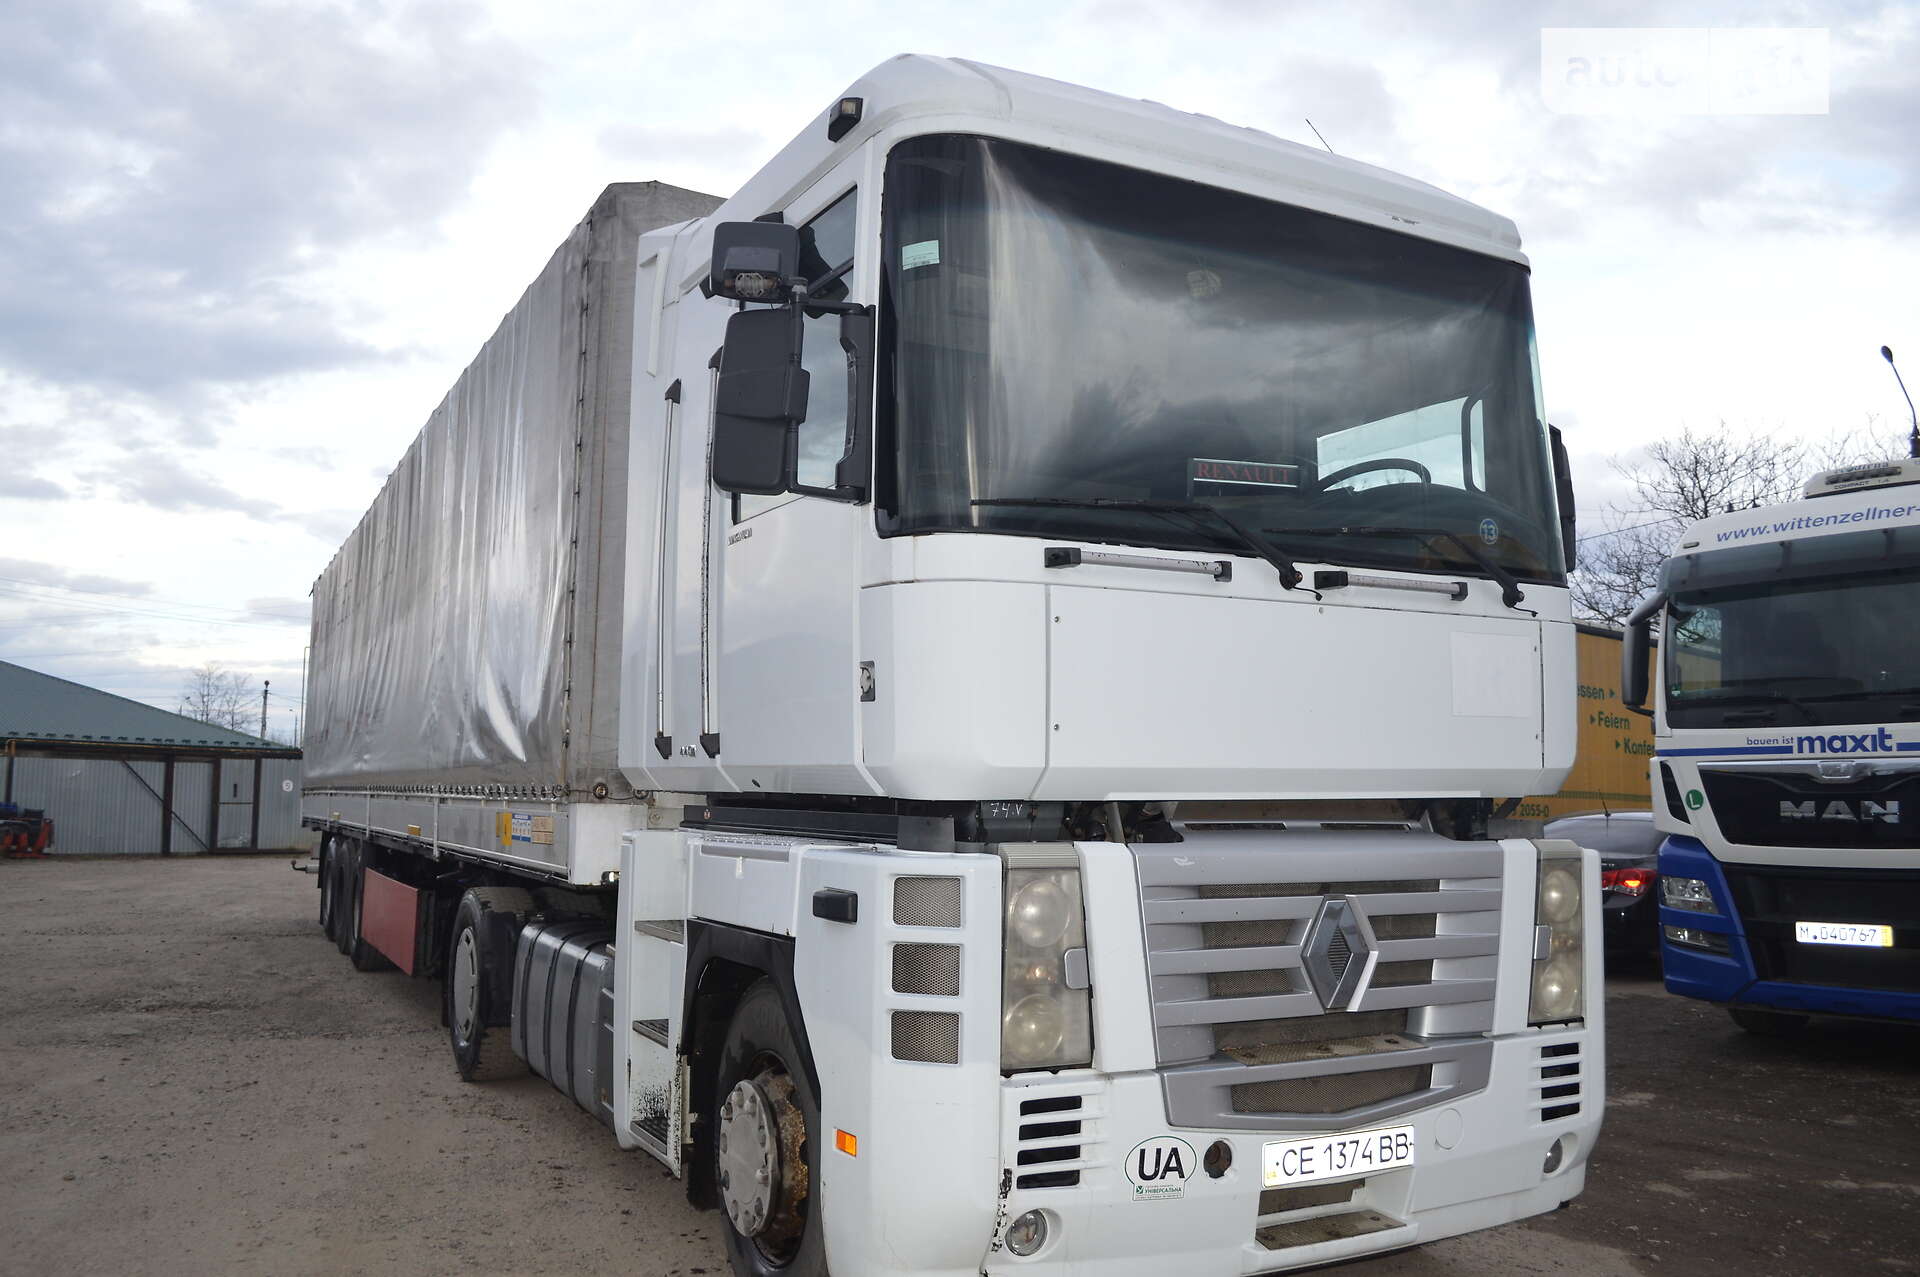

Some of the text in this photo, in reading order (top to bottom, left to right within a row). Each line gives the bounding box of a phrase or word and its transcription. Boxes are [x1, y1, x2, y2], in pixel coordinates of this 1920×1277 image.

[1194, 462, 1291, 484] RENAULT
[1598, 711, 1630, 729] Feiern
[1746, 727, 1893, 754] bauen ist maxit
[1779, 800, 1900, 824] MAN
[1138, 1147, 1186, 1181] UA
[1282, 1132, 1410, 1177] CE 1374 BB
